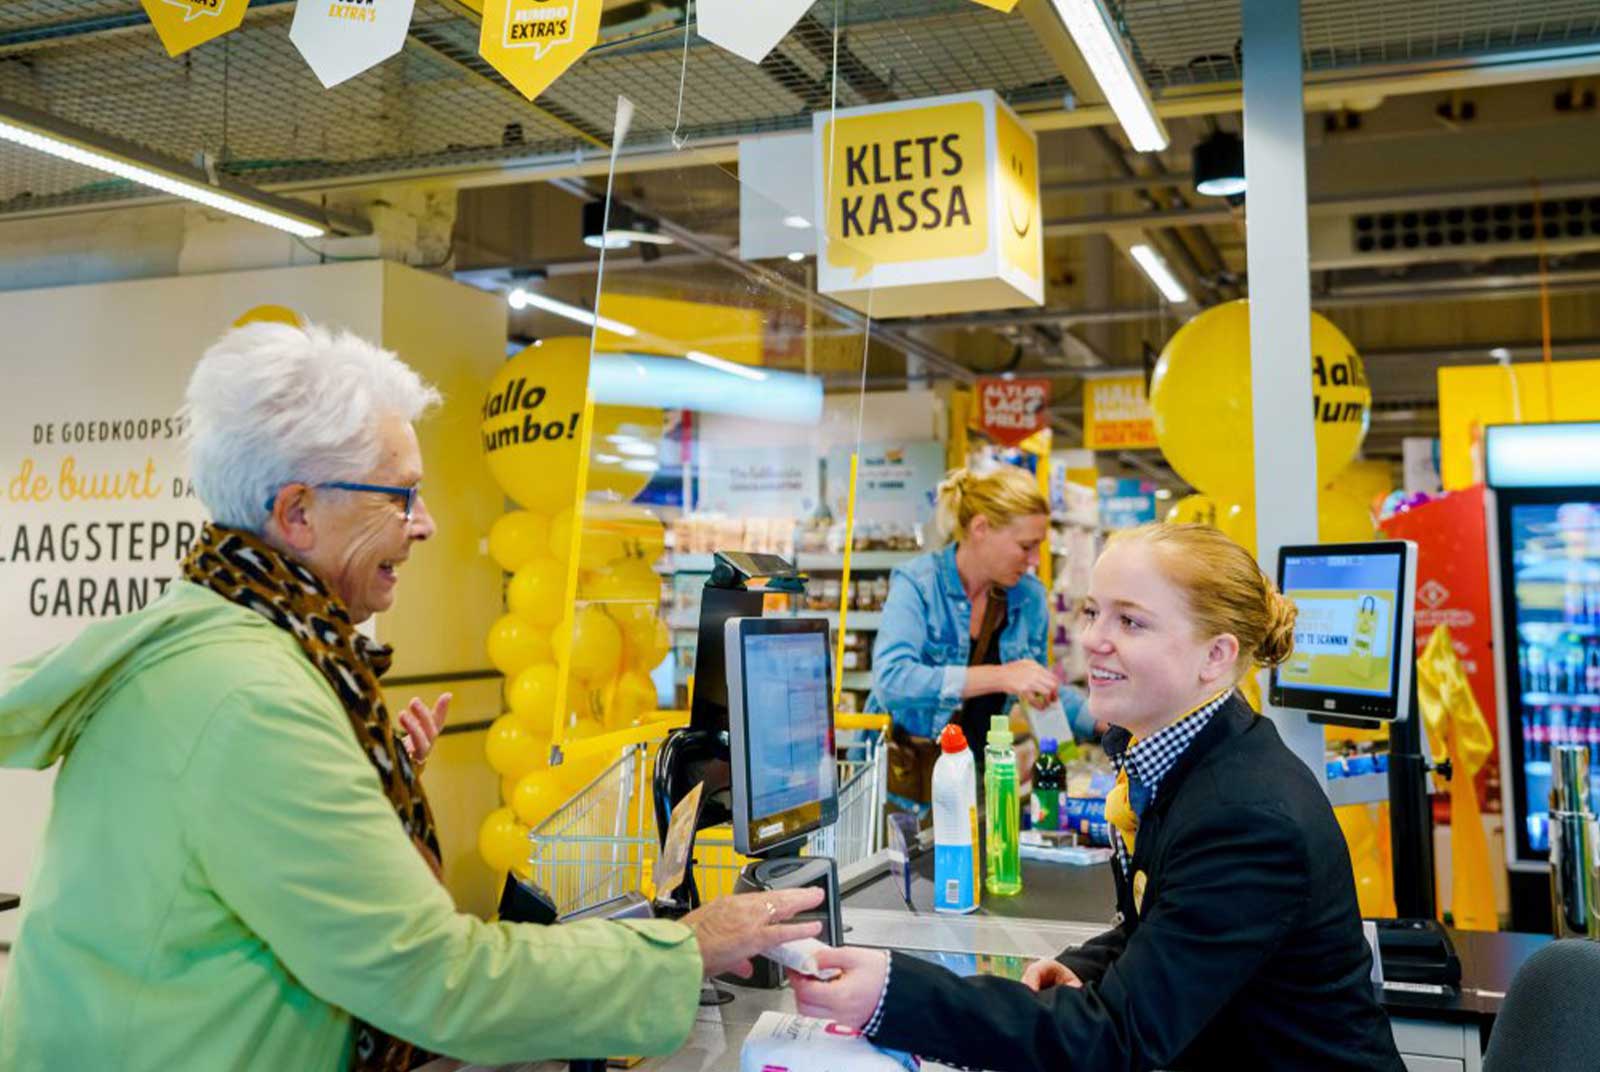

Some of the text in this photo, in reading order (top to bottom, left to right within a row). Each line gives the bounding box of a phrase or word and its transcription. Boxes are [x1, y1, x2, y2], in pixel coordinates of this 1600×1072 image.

[510, 20, 567, 39] EXTRA'S
[846, 133, 963, 187] KLETS
[841, 185, 972, 238] KASSA
[33, 424, 54, 444] DE
[9, 457, 51, 503] de
[58, 454, 163, 502] buurt
